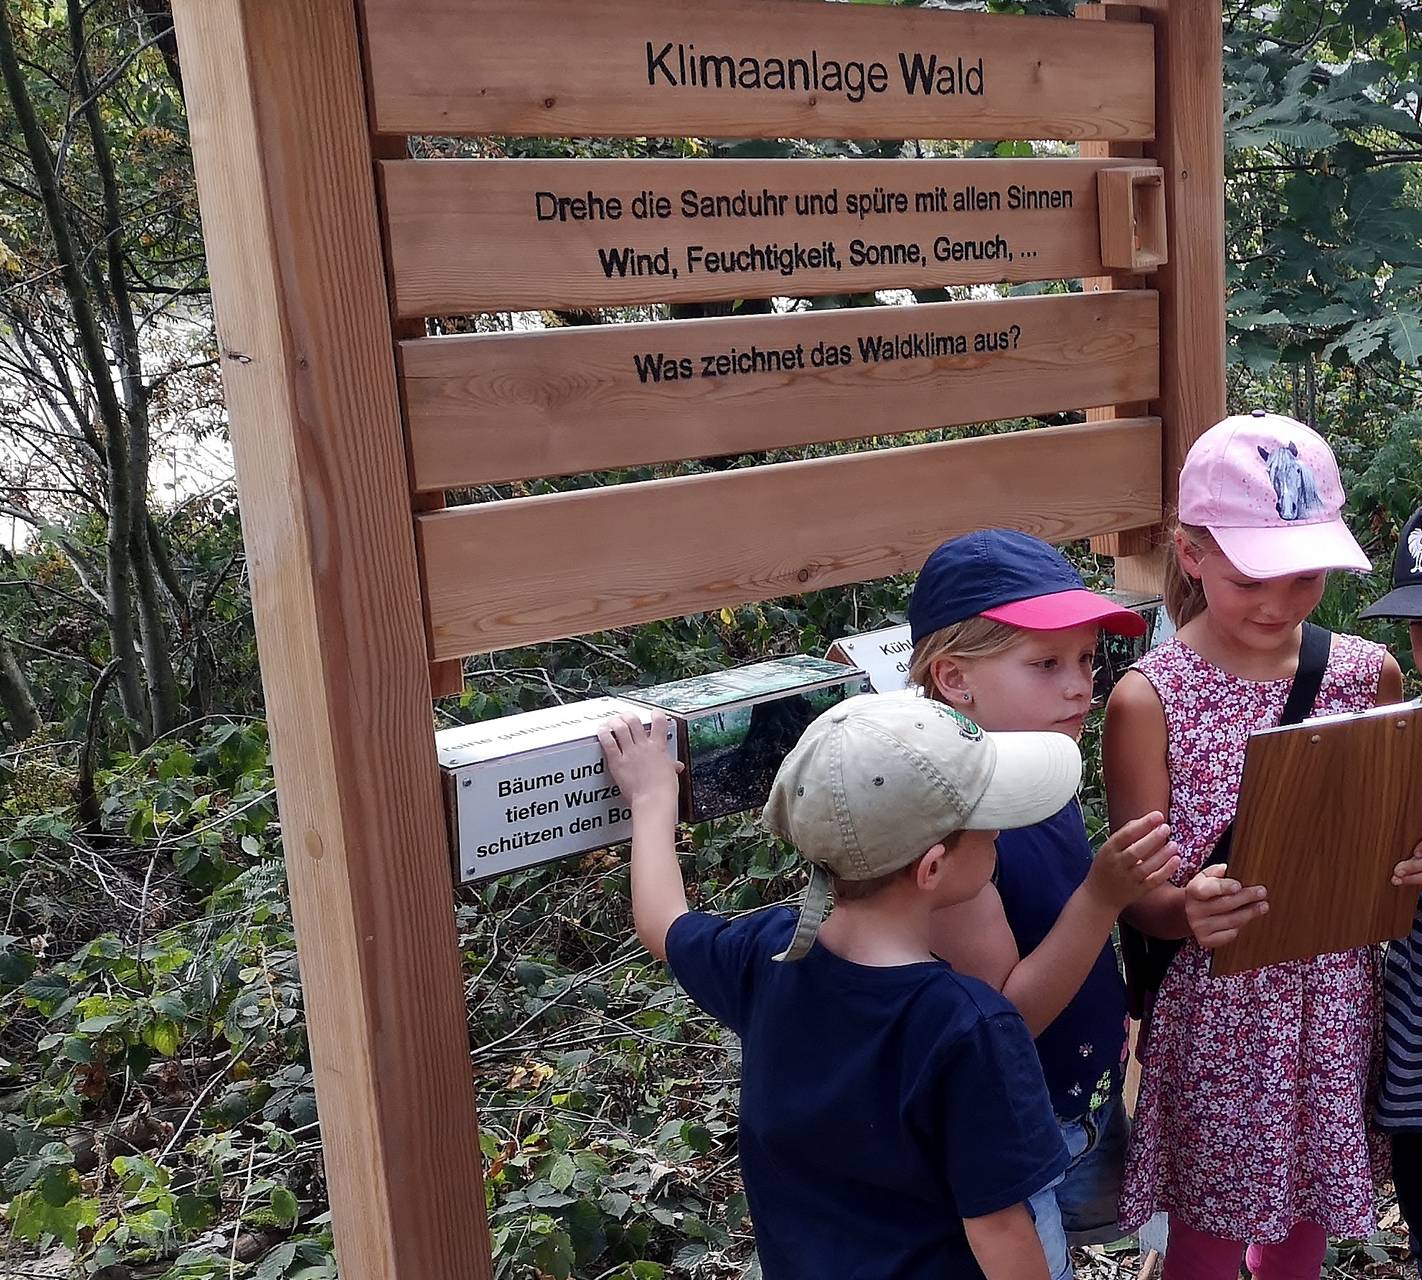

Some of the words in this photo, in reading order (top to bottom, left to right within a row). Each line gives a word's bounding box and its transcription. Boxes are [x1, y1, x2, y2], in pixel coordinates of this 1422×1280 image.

[646, 41, 888, 102] Klimaanlage
[899, 52, 984, 95] Wald
[535, 191, 622, 222] Drehe
[632, 190, 672, 219] die
[681, 189, 788, 218] Sanduhr
[796, 189, 838, 216] und
[846, 187, 908, 220] spüre
[916, 187, 948, 213] mit
[953, 186, 1001, 212] allen
[1007, 185, 1073, 209] Sinnen
[598, 247, 678, 279] Wind,
[687, 242, 842, 276] Feuchtigkeit,
[849, 239, 927, 267] Sonne,
[934, 235, 1013, 262] Geruch,
[634, 354, 693, 383] Was
[701, 344, 803, 377] zeichnet
[811, 341, 852, 367] das
[857, 333, 967, 364] Waldklima
[974, 324, 1021, 353] aus?
[879, 639, 915, 656] Kühl
[498, 771, 565, 797] Bäume
[570, 758, 605, 780] und
[505, 800, 559, 823] tiefen
[565, 784, 622, 808] Wurze
[476, 825, 563, 858] schützen
[569, 814, 603, 834] den
